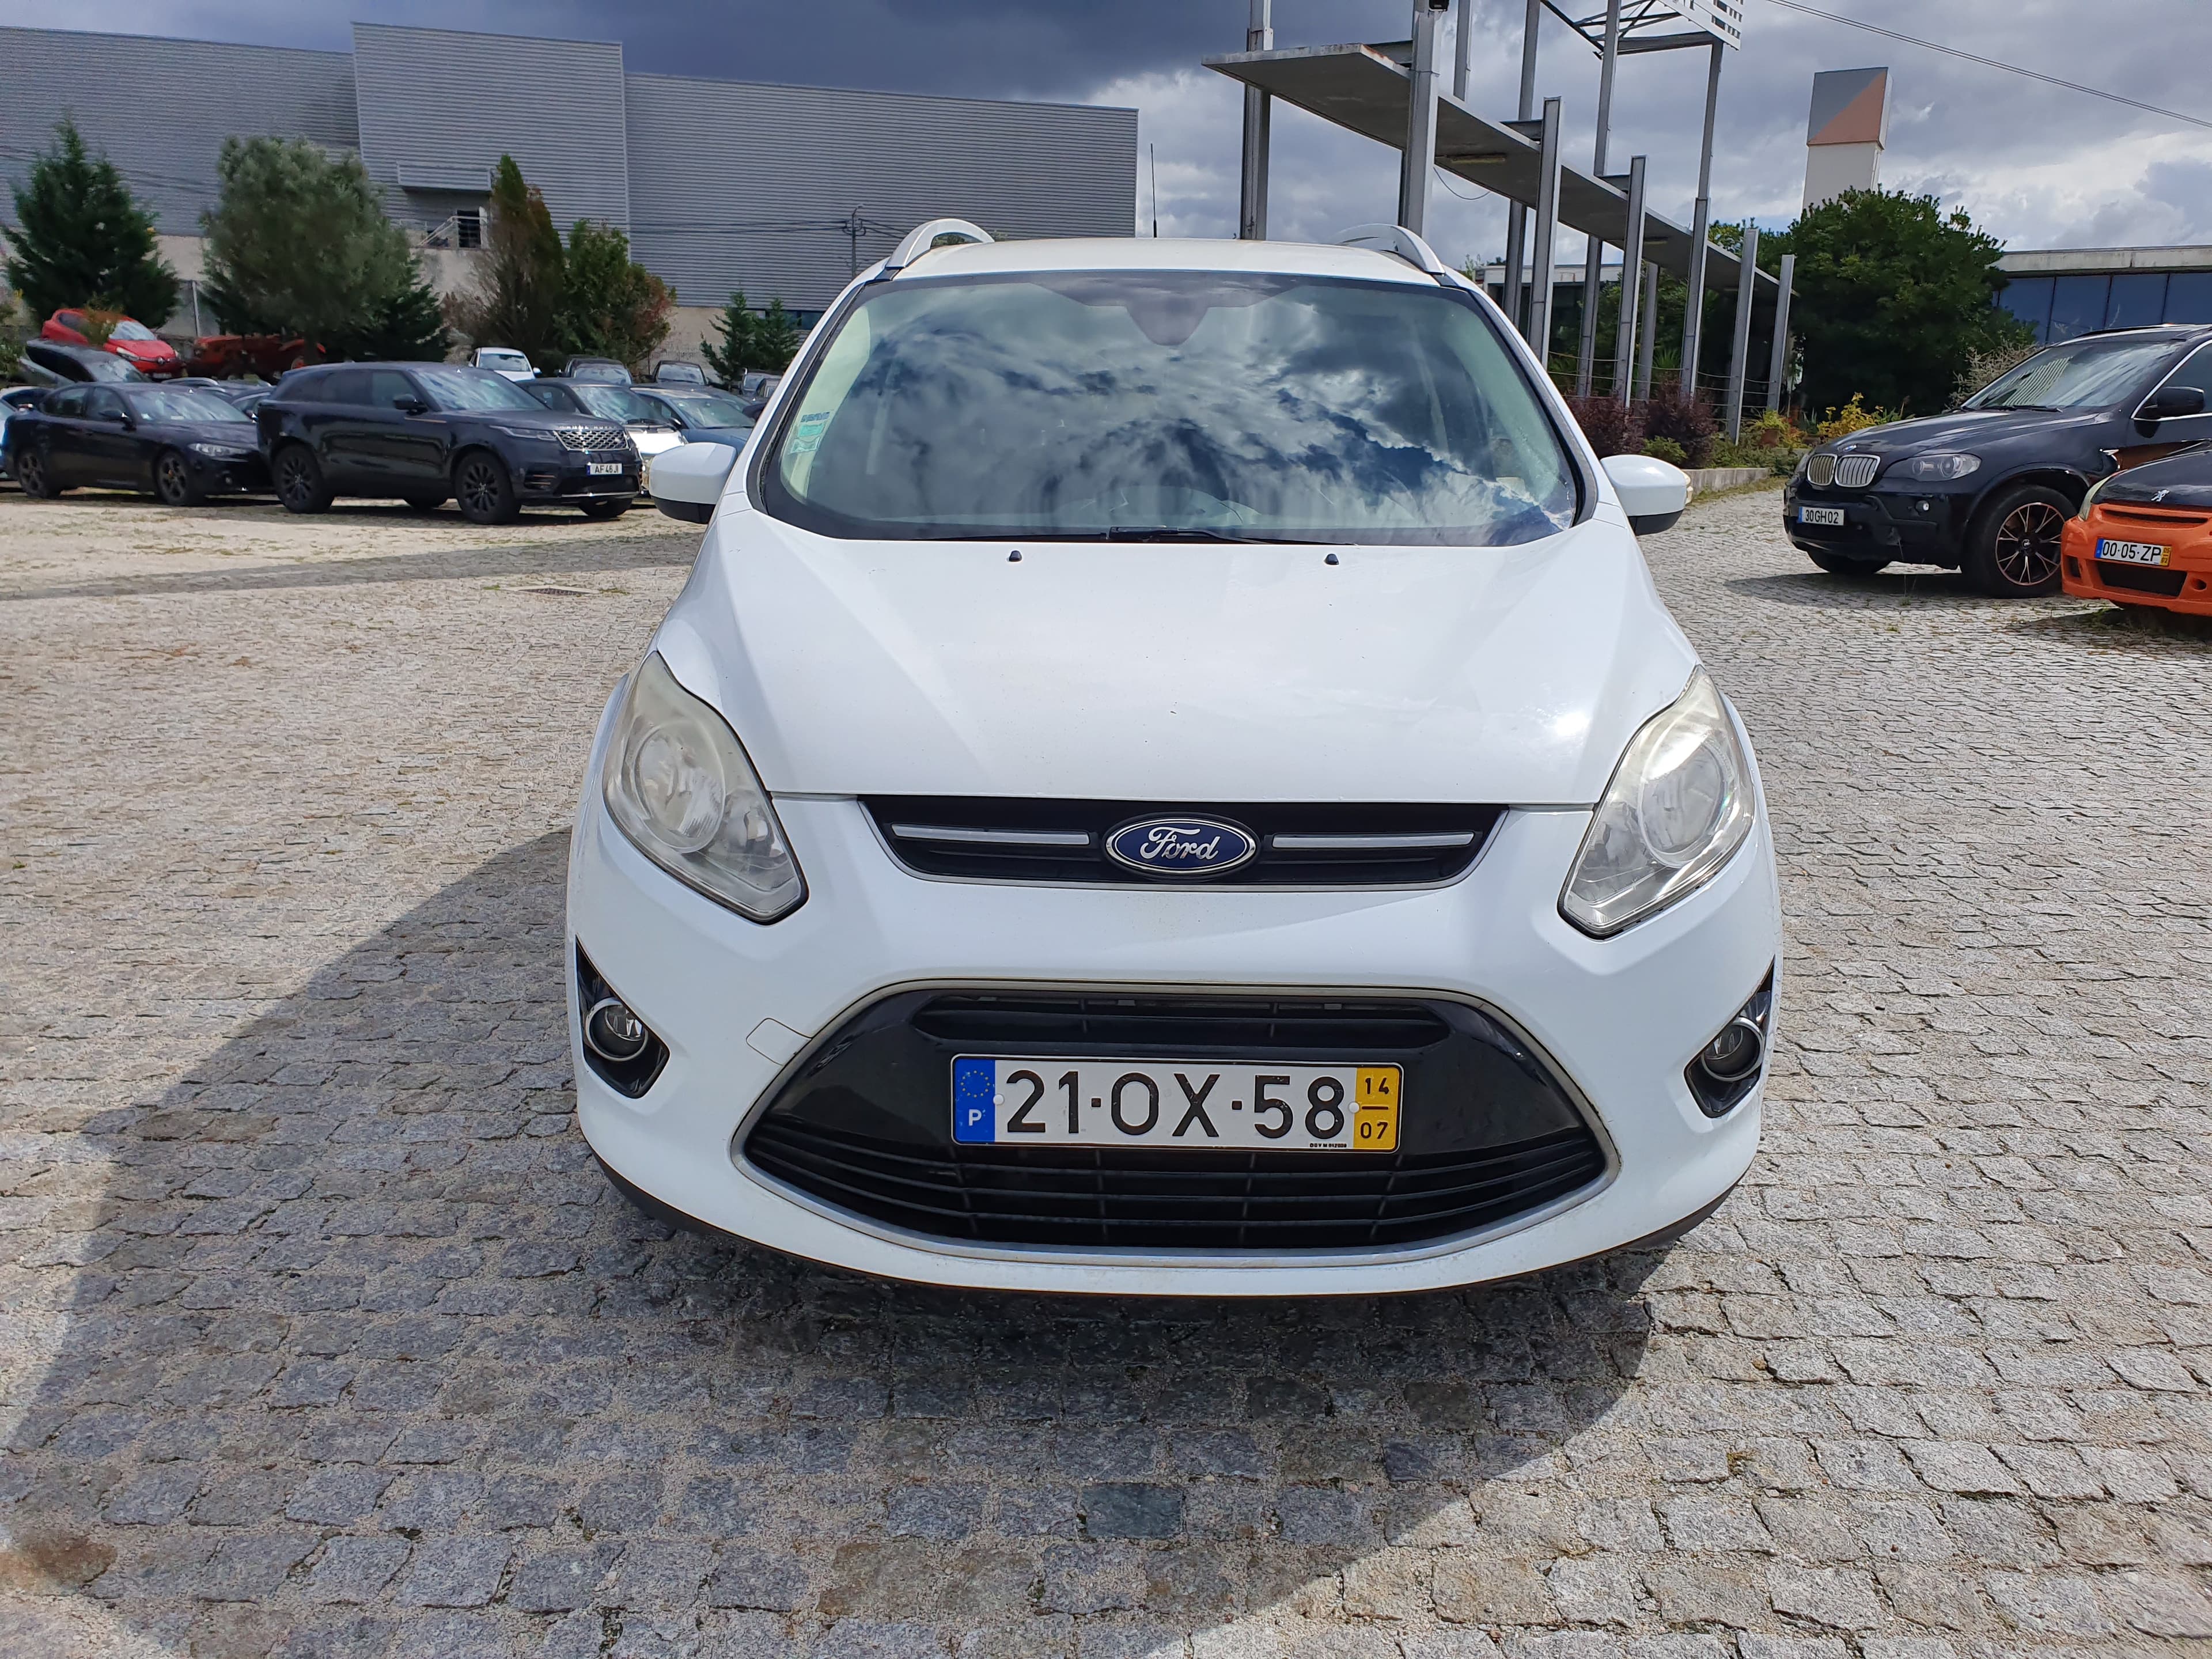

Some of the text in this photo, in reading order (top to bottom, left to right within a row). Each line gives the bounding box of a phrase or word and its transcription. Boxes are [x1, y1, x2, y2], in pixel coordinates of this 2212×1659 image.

[1140, 827, 1221, 859] Ford
[1365, 1077, 1389, 1094] 14
[968, 1109, 982, 1126] P
[1360, 1121, 1388, 1139] 07
